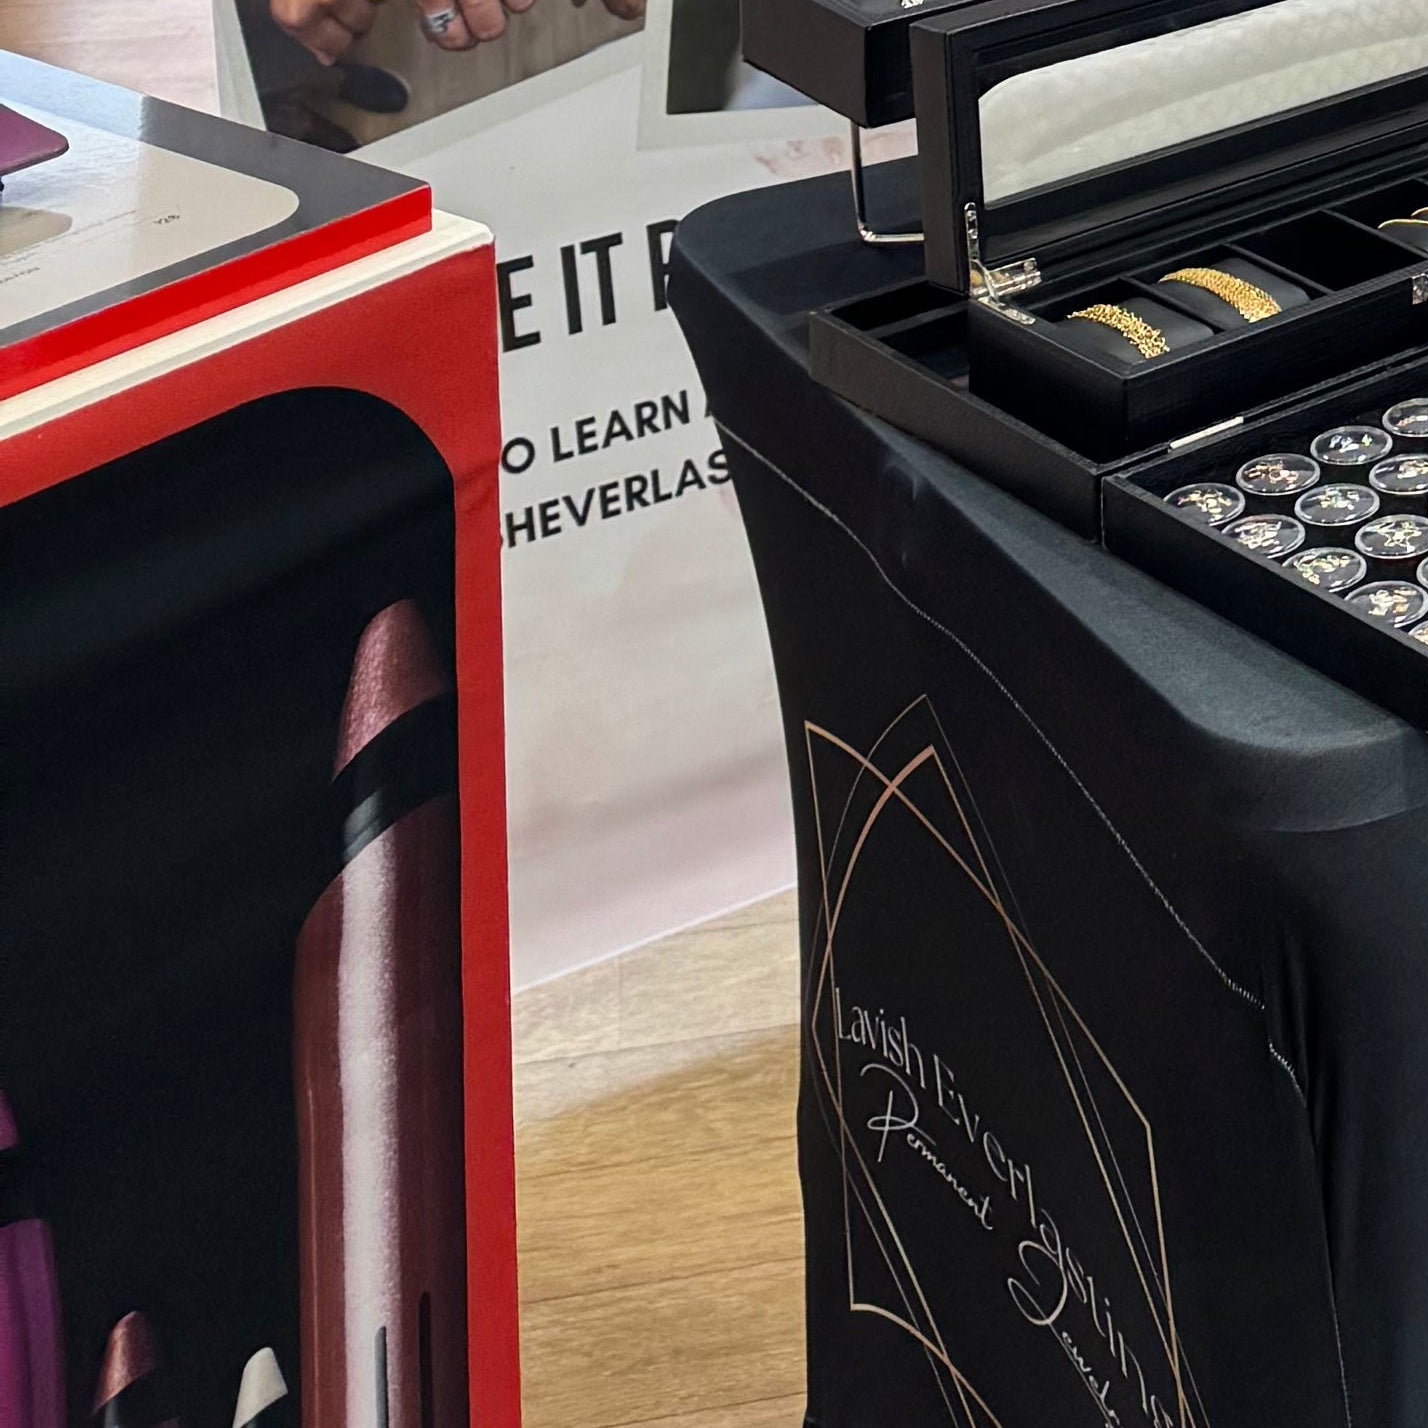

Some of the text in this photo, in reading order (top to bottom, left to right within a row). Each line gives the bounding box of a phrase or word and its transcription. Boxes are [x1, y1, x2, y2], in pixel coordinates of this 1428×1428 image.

[496, 254, 541, 353] E
[560, 231, 624, 336] IT
[501, 389, 692, 475] O LEARN
[501, 448, 733, 549] HEVERLAS
[835, 987, 927, 1089] Lavish
[861, 1062, 994, 1230] Permanent
